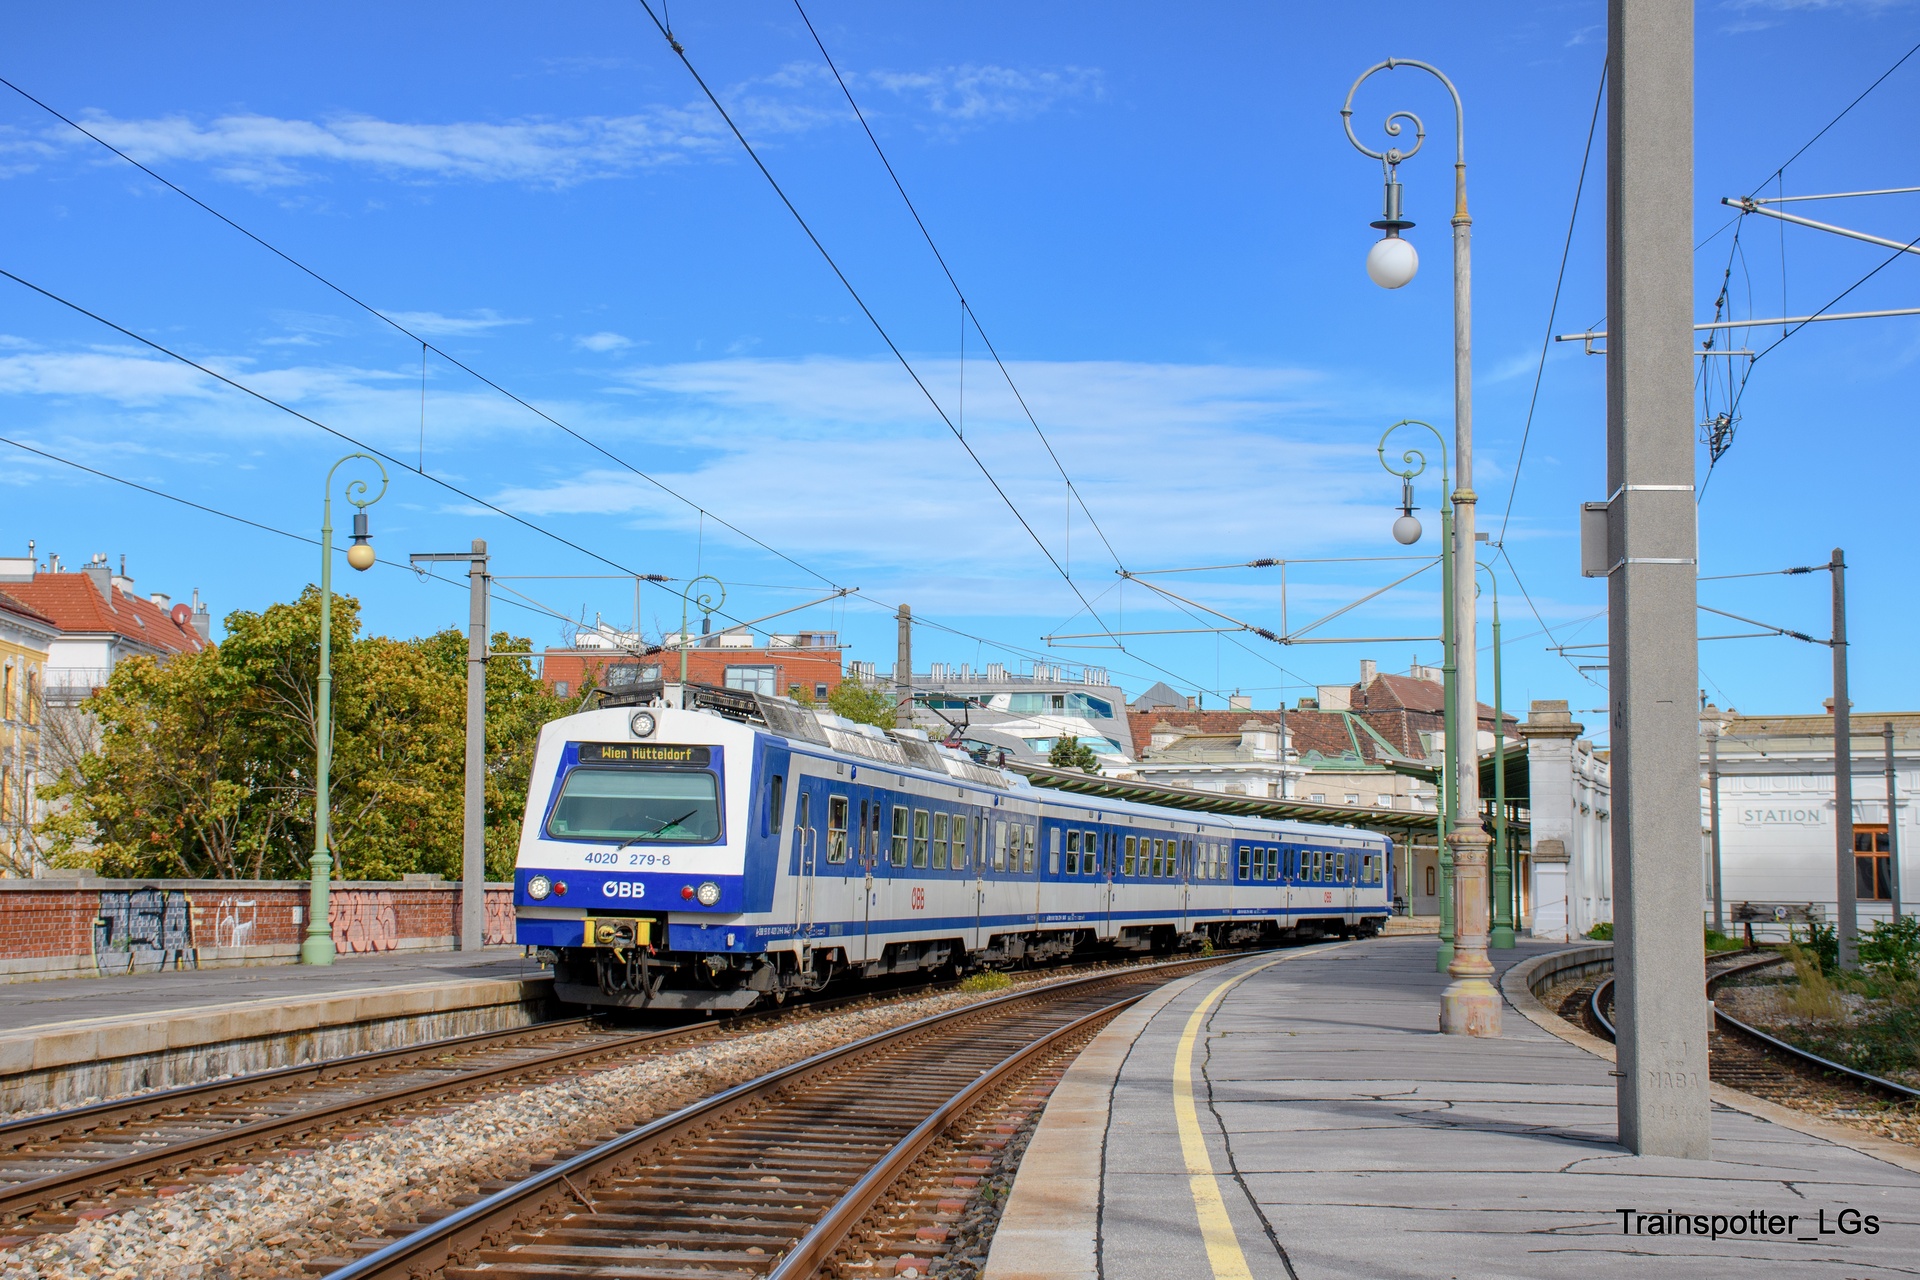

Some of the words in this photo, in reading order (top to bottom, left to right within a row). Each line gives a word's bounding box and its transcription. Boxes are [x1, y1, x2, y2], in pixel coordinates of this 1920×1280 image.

[602, 747, 627, 759] Wien
[632, 747, 692, 760] Hütteldorf
[1744, 809, 1820, 822] STATION
[584, 853, 618, 864] 4020
[630, 854, 671, 865] 279-8
[602, 881, 645, 898] ÖBB
[911, 887, 925, 910] ÖBB
